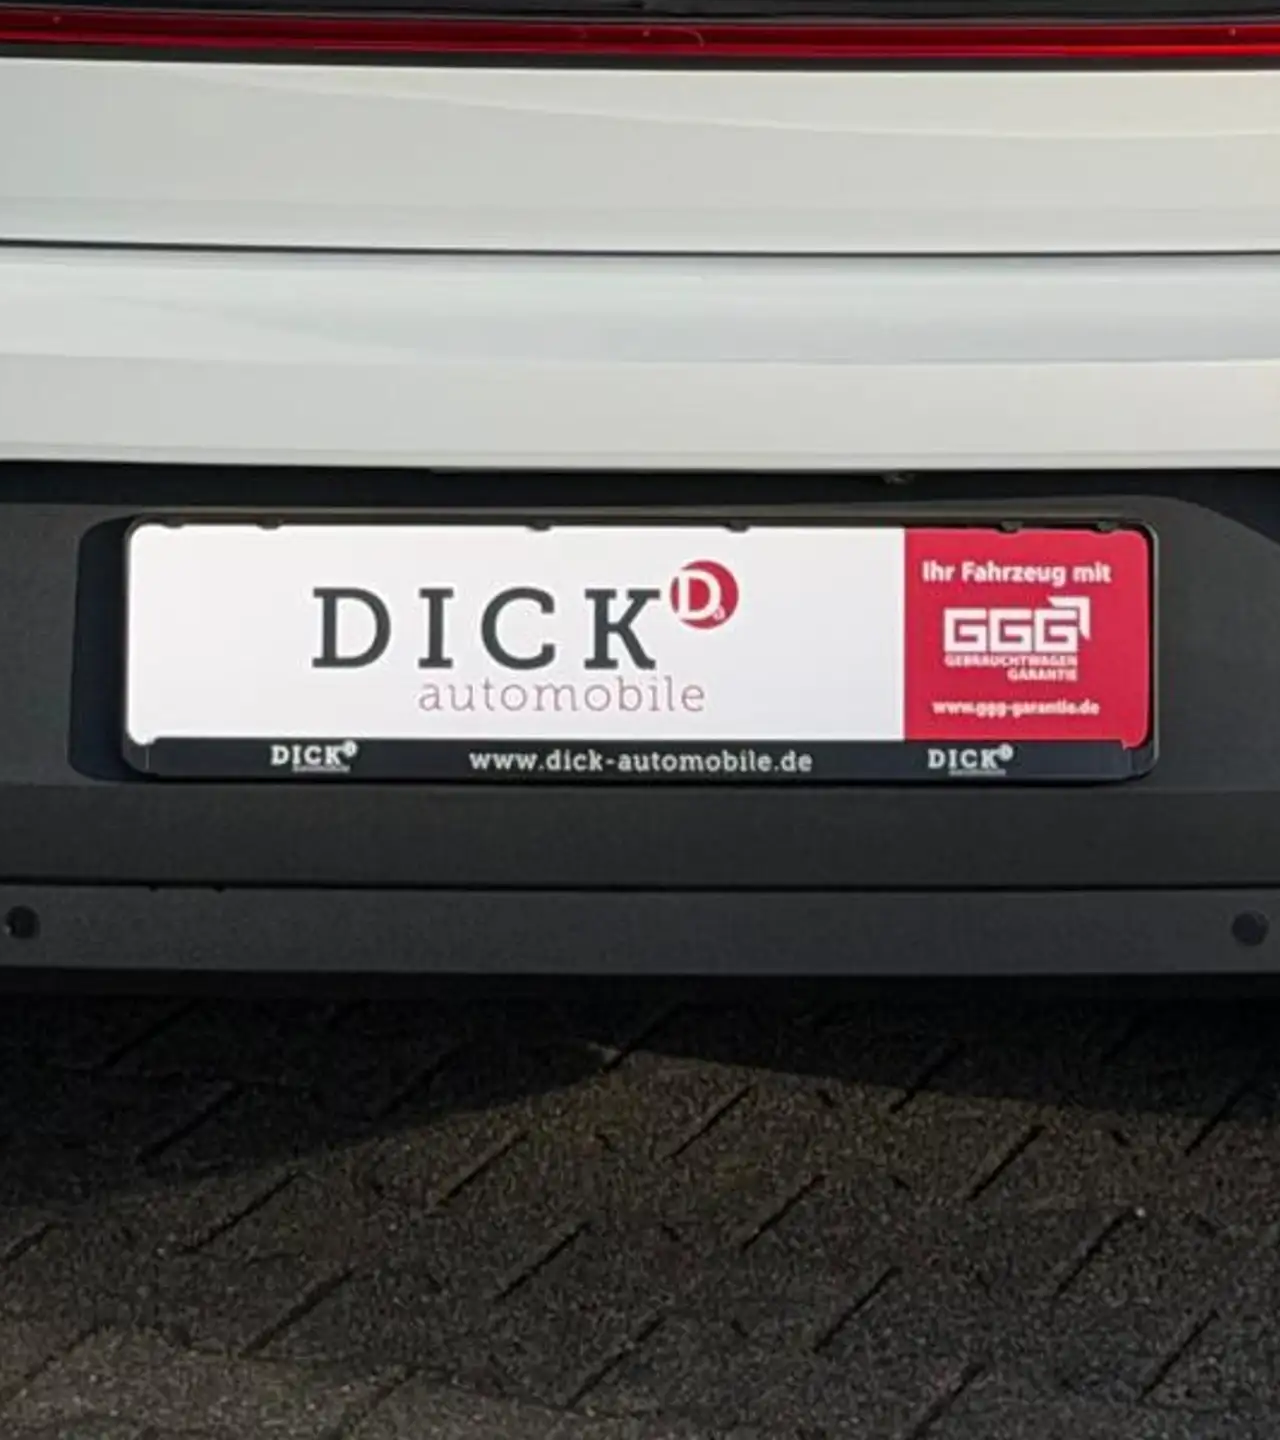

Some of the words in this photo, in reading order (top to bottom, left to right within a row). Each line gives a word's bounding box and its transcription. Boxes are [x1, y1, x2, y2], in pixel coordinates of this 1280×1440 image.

[922, 561, 954, 582] Ihr
[961, 561, 1066, 587] Fahrzeug
[1073, 562, 1112, 583] mit
[312, 587, 661, 670] DICK
[944, 608, 1078, 653] GGG
[944, 655, 1078, 668] GEBRAUCHTWAGEN
[1007, 669, 1078, 682] GARANTIE
[419, 676, 705, 713] automobile
[932, 699, 1101, 718] www.ggg-garantie.de
[270, 744, 341, 766] DICK
[469, 749, 813, 773] www.dick-automobile.de
[927, 748, 998, 770] DICK
